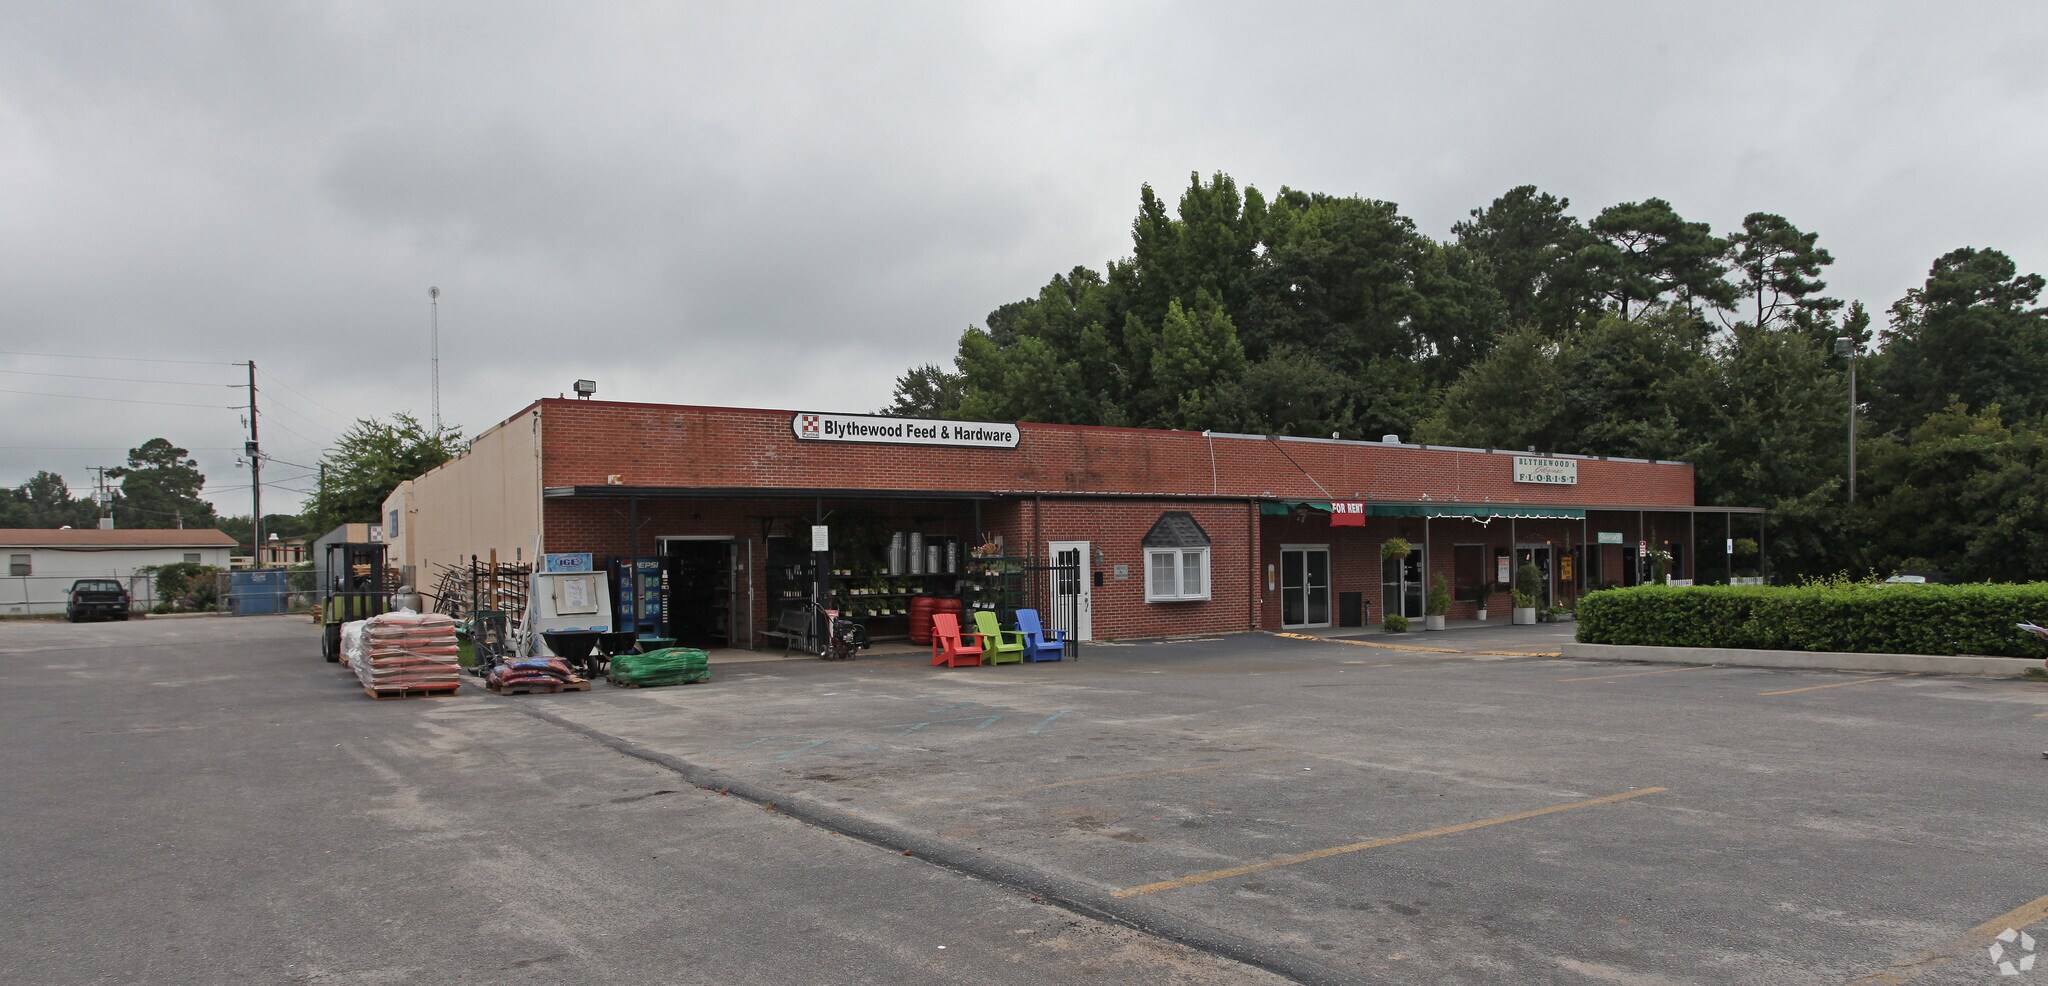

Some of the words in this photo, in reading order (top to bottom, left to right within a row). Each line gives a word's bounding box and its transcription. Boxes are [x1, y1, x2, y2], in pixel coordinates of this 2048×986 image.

[824, 420, 902, 438] Blythewood
[906, 423, 937, 439] Feed
[940, 425, 950, 439] &
[954, 426, 1012, 442] Hardware
[1331, 503, 1346, 514] FOR
[1347, 503, 1363, 514] RENT
[559, 558, 581, 566] ICE
